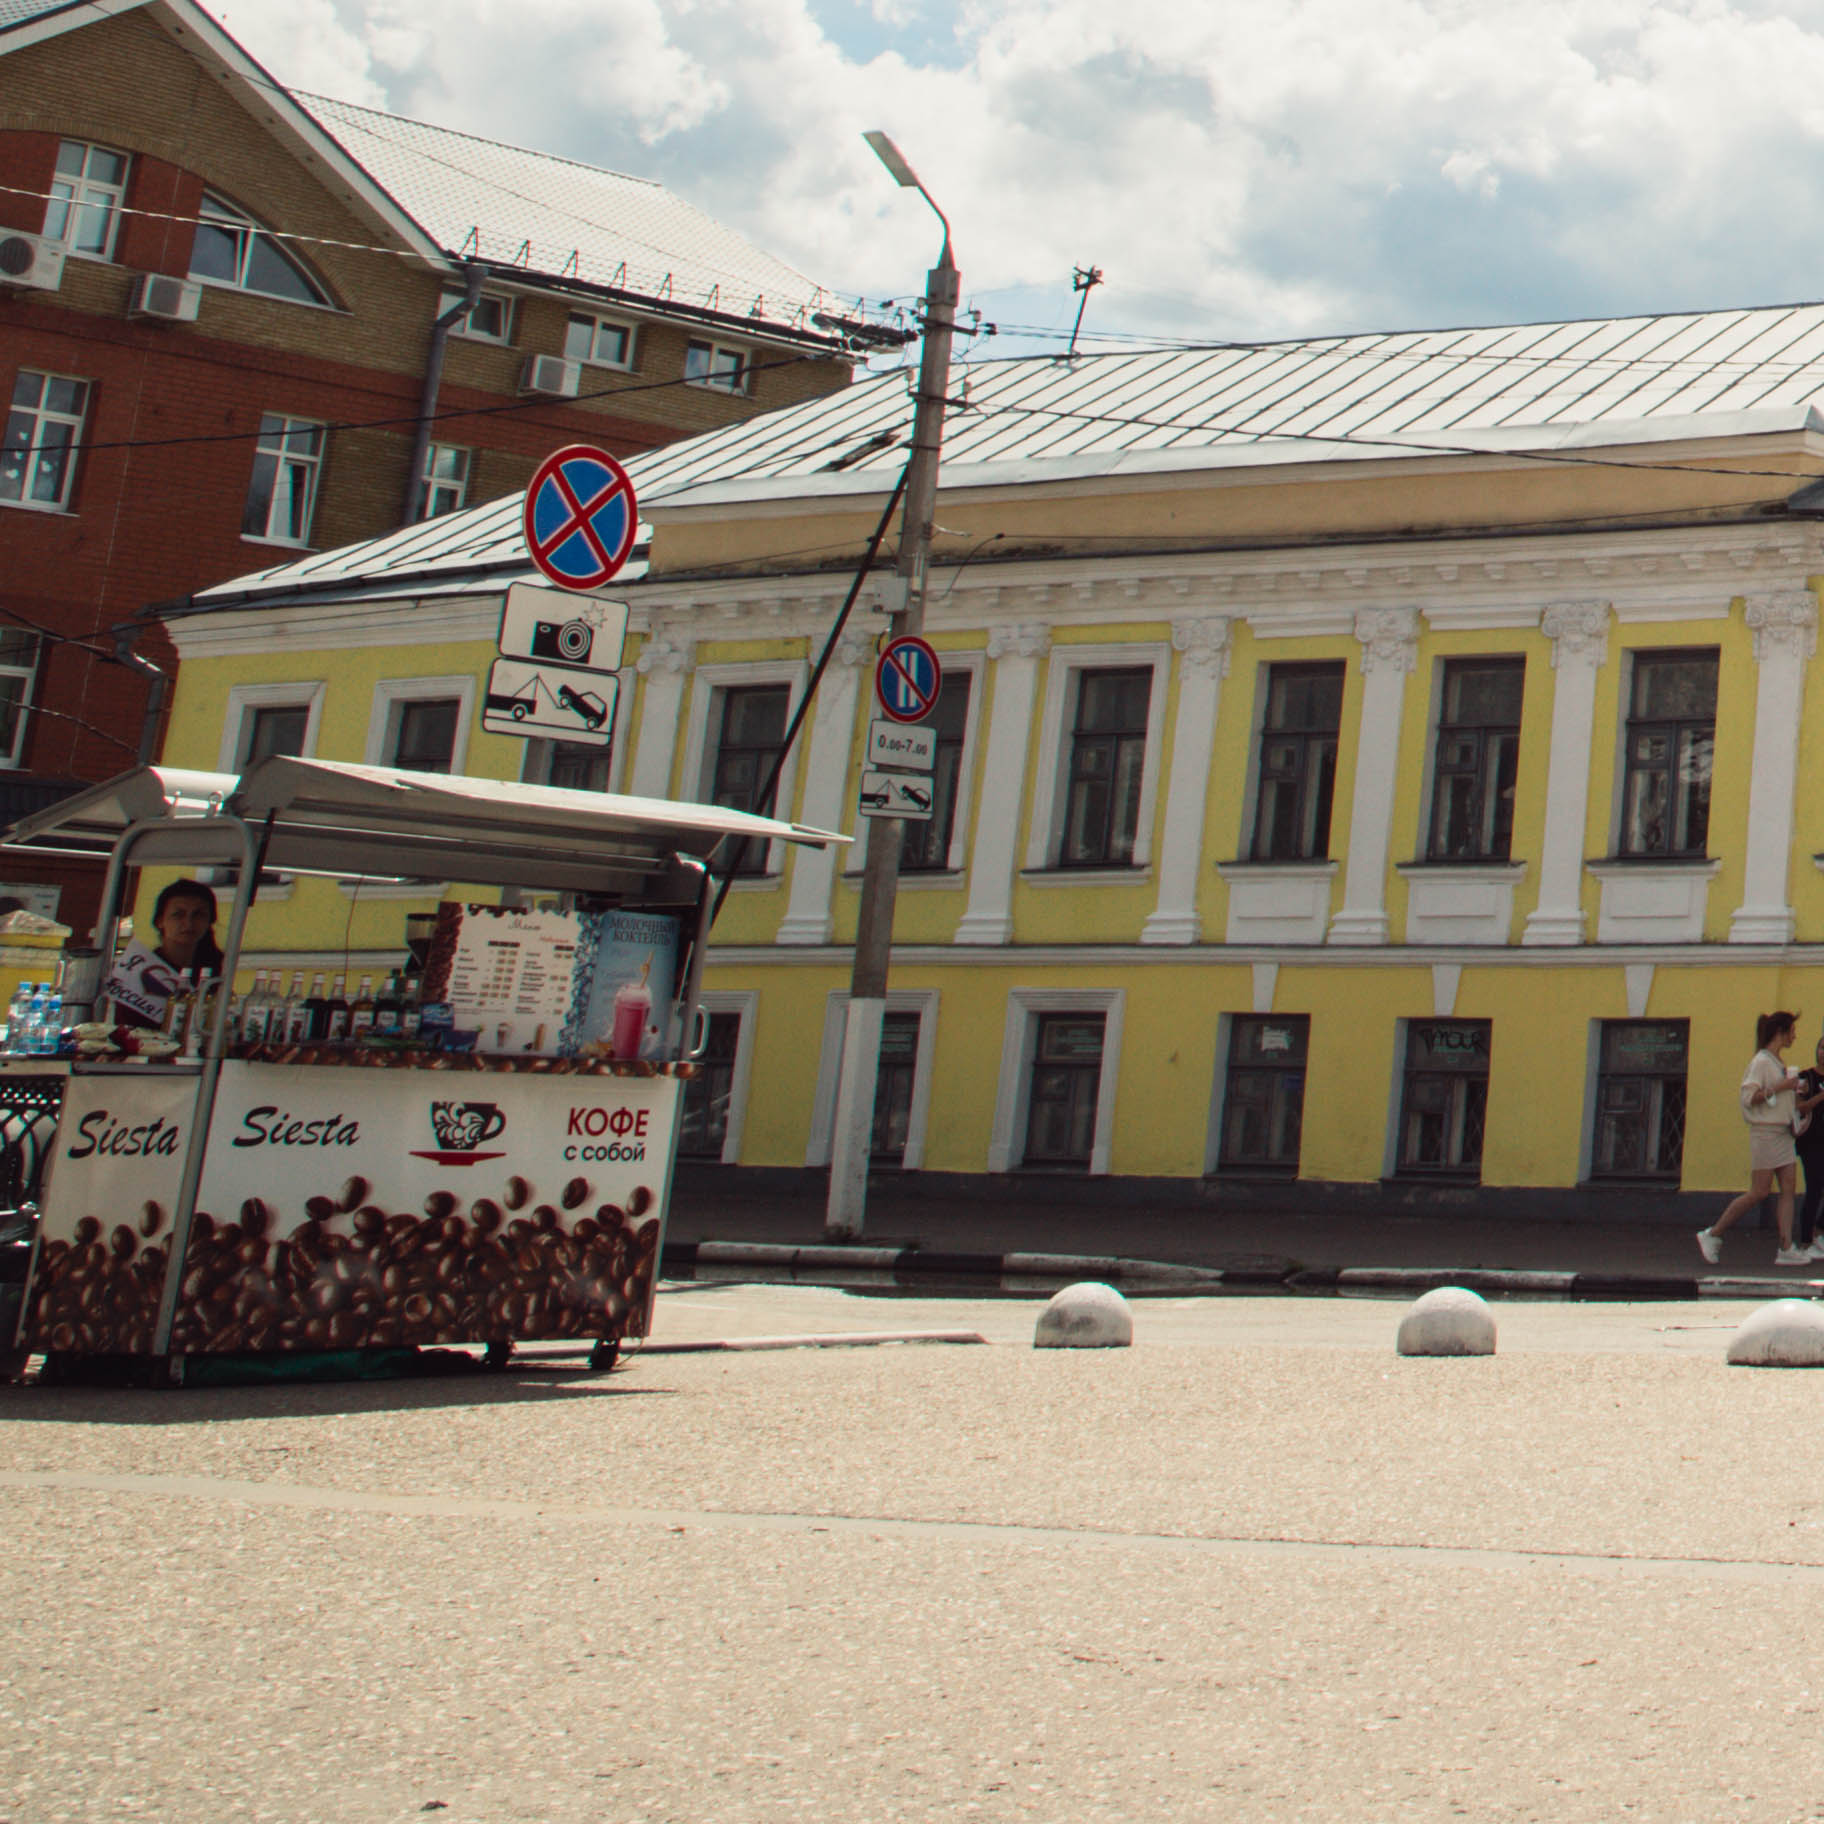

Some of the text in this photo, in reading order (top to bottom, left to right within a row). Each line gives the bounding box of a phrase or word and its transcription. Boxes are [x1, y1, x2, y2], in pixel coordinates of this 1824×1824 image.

[68, 1110, 180, 1159] Siesta
[232, 1106, 360, 1147] Siesta
[567, 1107, 649, 1138] КОФЕ
[563, 1142, 646, 1162] с собой
